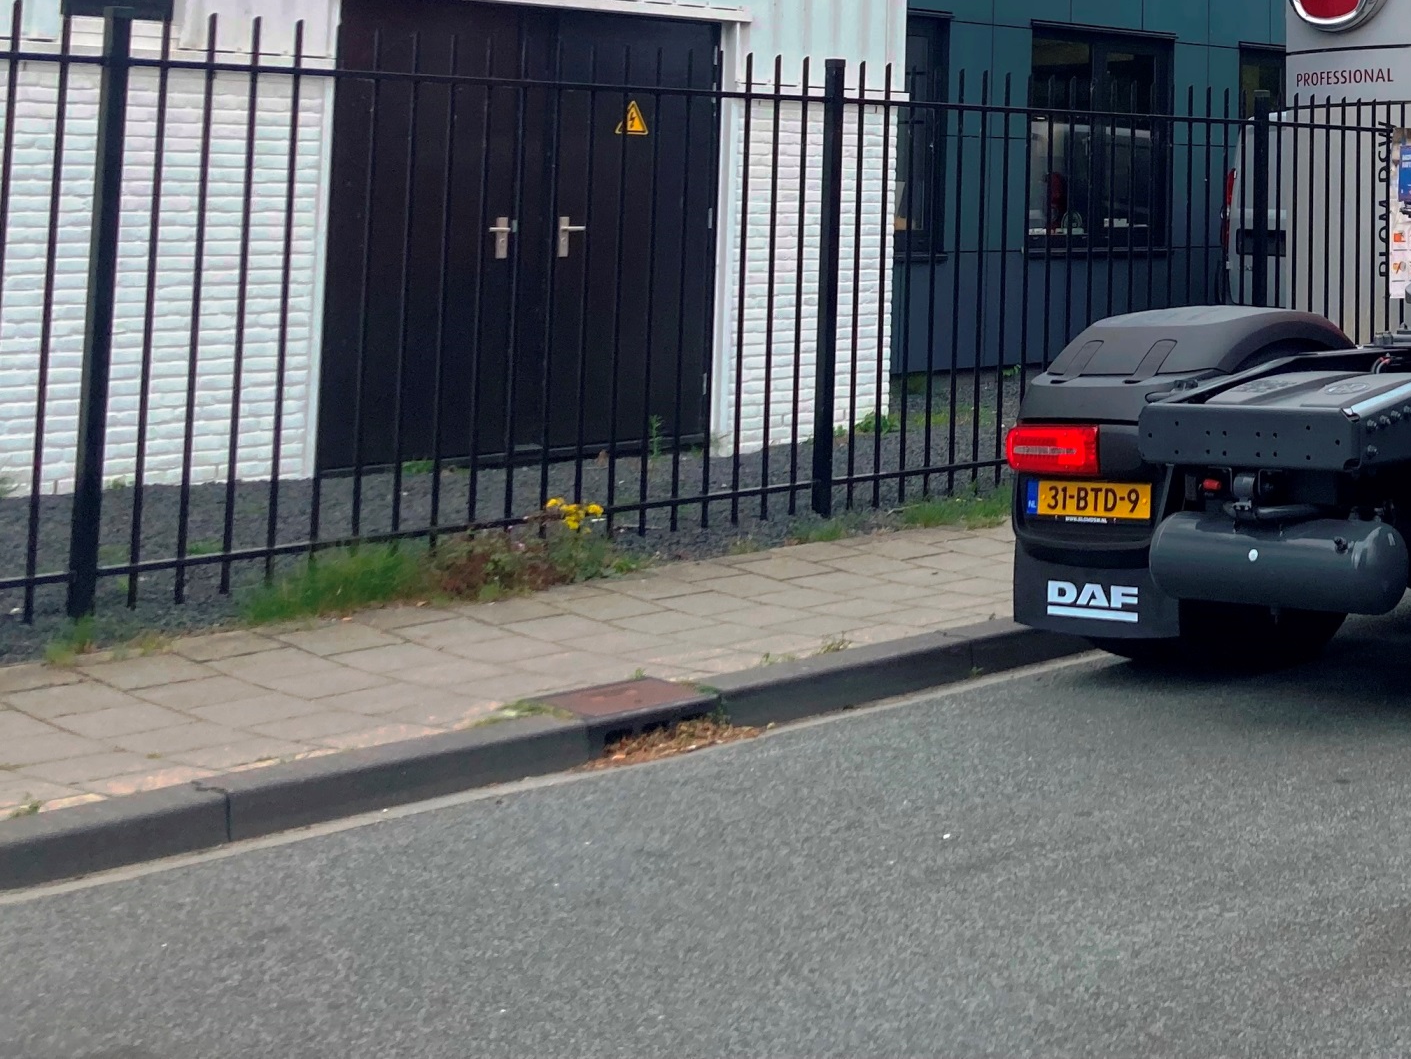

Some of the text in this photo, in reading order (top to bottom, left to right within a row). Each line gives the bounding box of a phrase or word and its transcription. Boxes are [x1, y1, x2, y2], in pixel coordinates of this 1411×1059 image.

[1296, 68, 1394, 87] PROFESSIONAL
[1027, 500, 1037, 509] NL
[1046, 486, 1140, 513] 31-BTD-9
[1047, 580, 1139, 608] DAF
